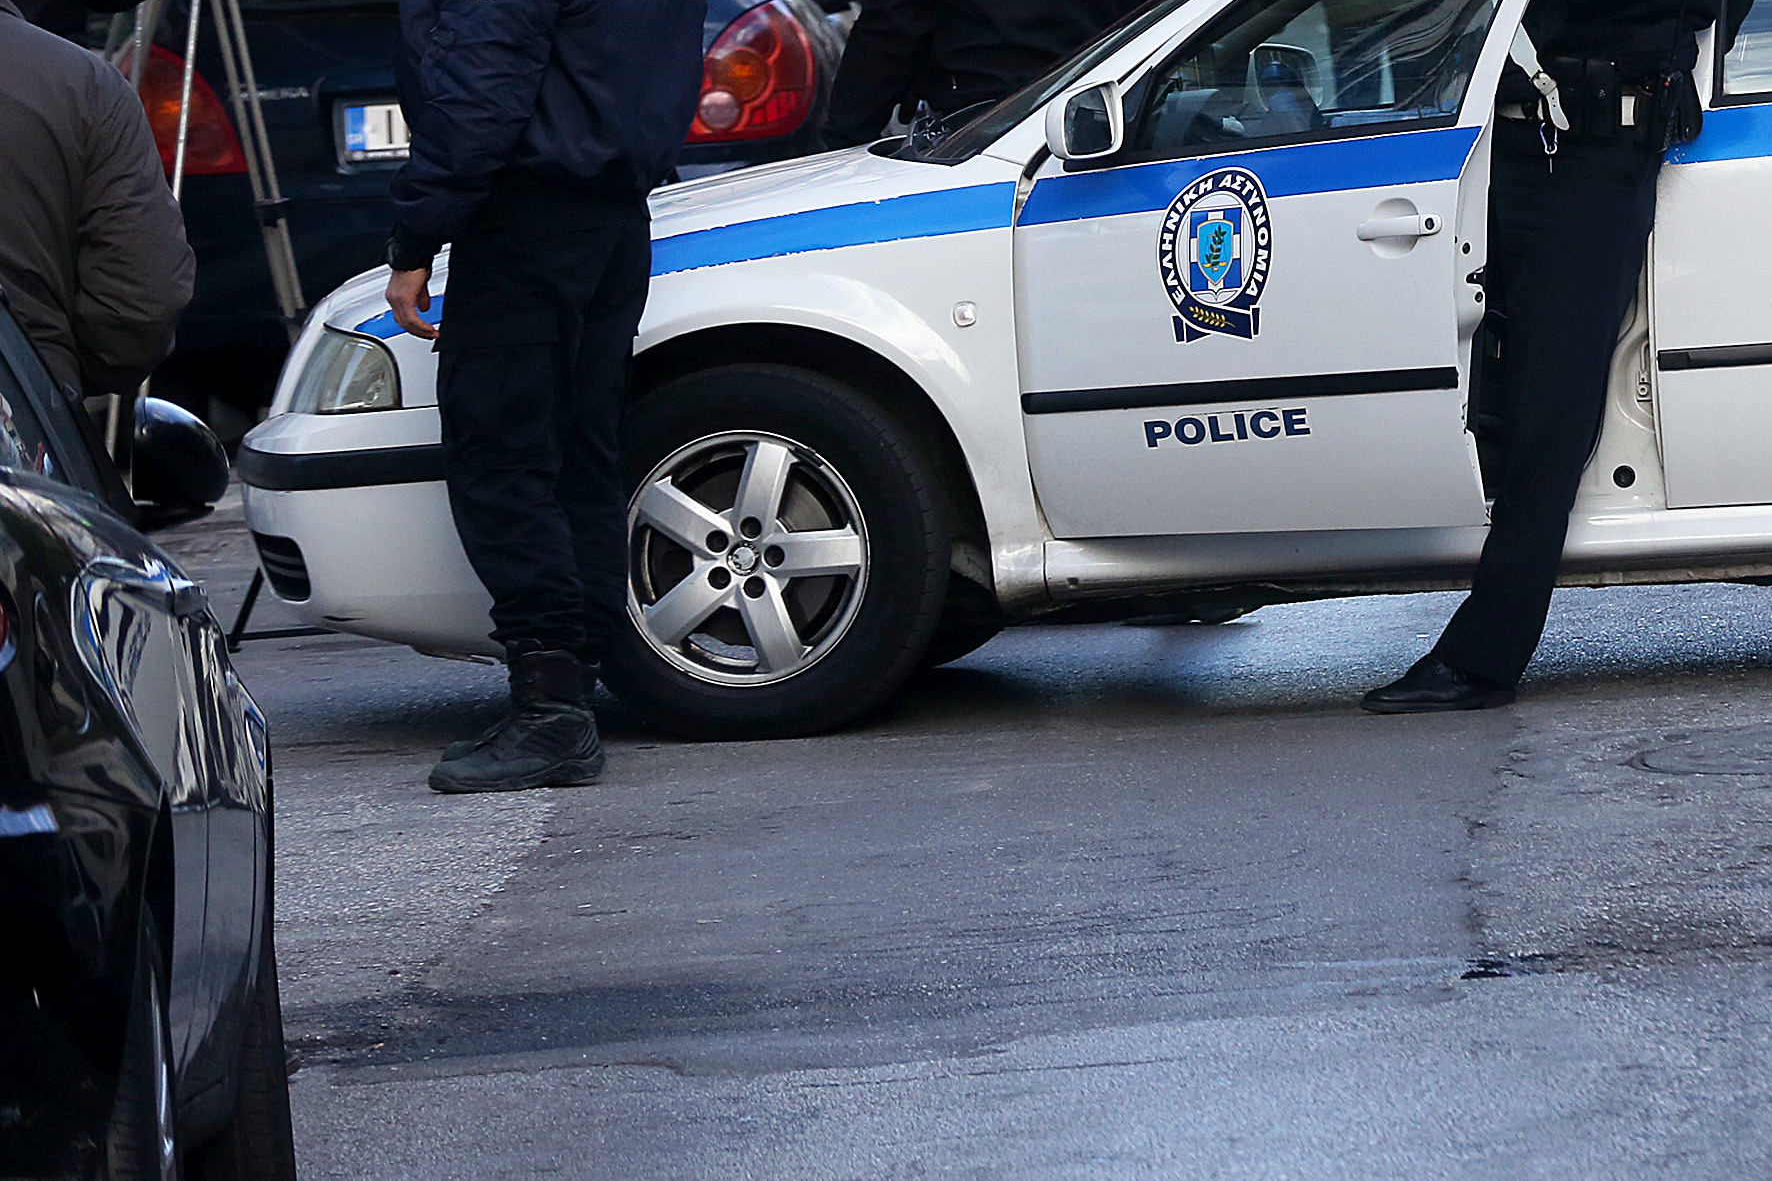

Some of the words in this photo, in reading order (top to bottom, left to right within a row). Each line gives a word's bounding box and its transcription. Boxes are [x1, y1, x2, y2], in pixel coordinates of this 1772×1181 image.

[1161, 177, 1214, 306] ΕΛΛΗΝΙΚΗ
[1218, 172, 1270, 297] ΑΣΤΥΝΟΜΙΑ
[1143, 407, 1311, 449] POLICE
